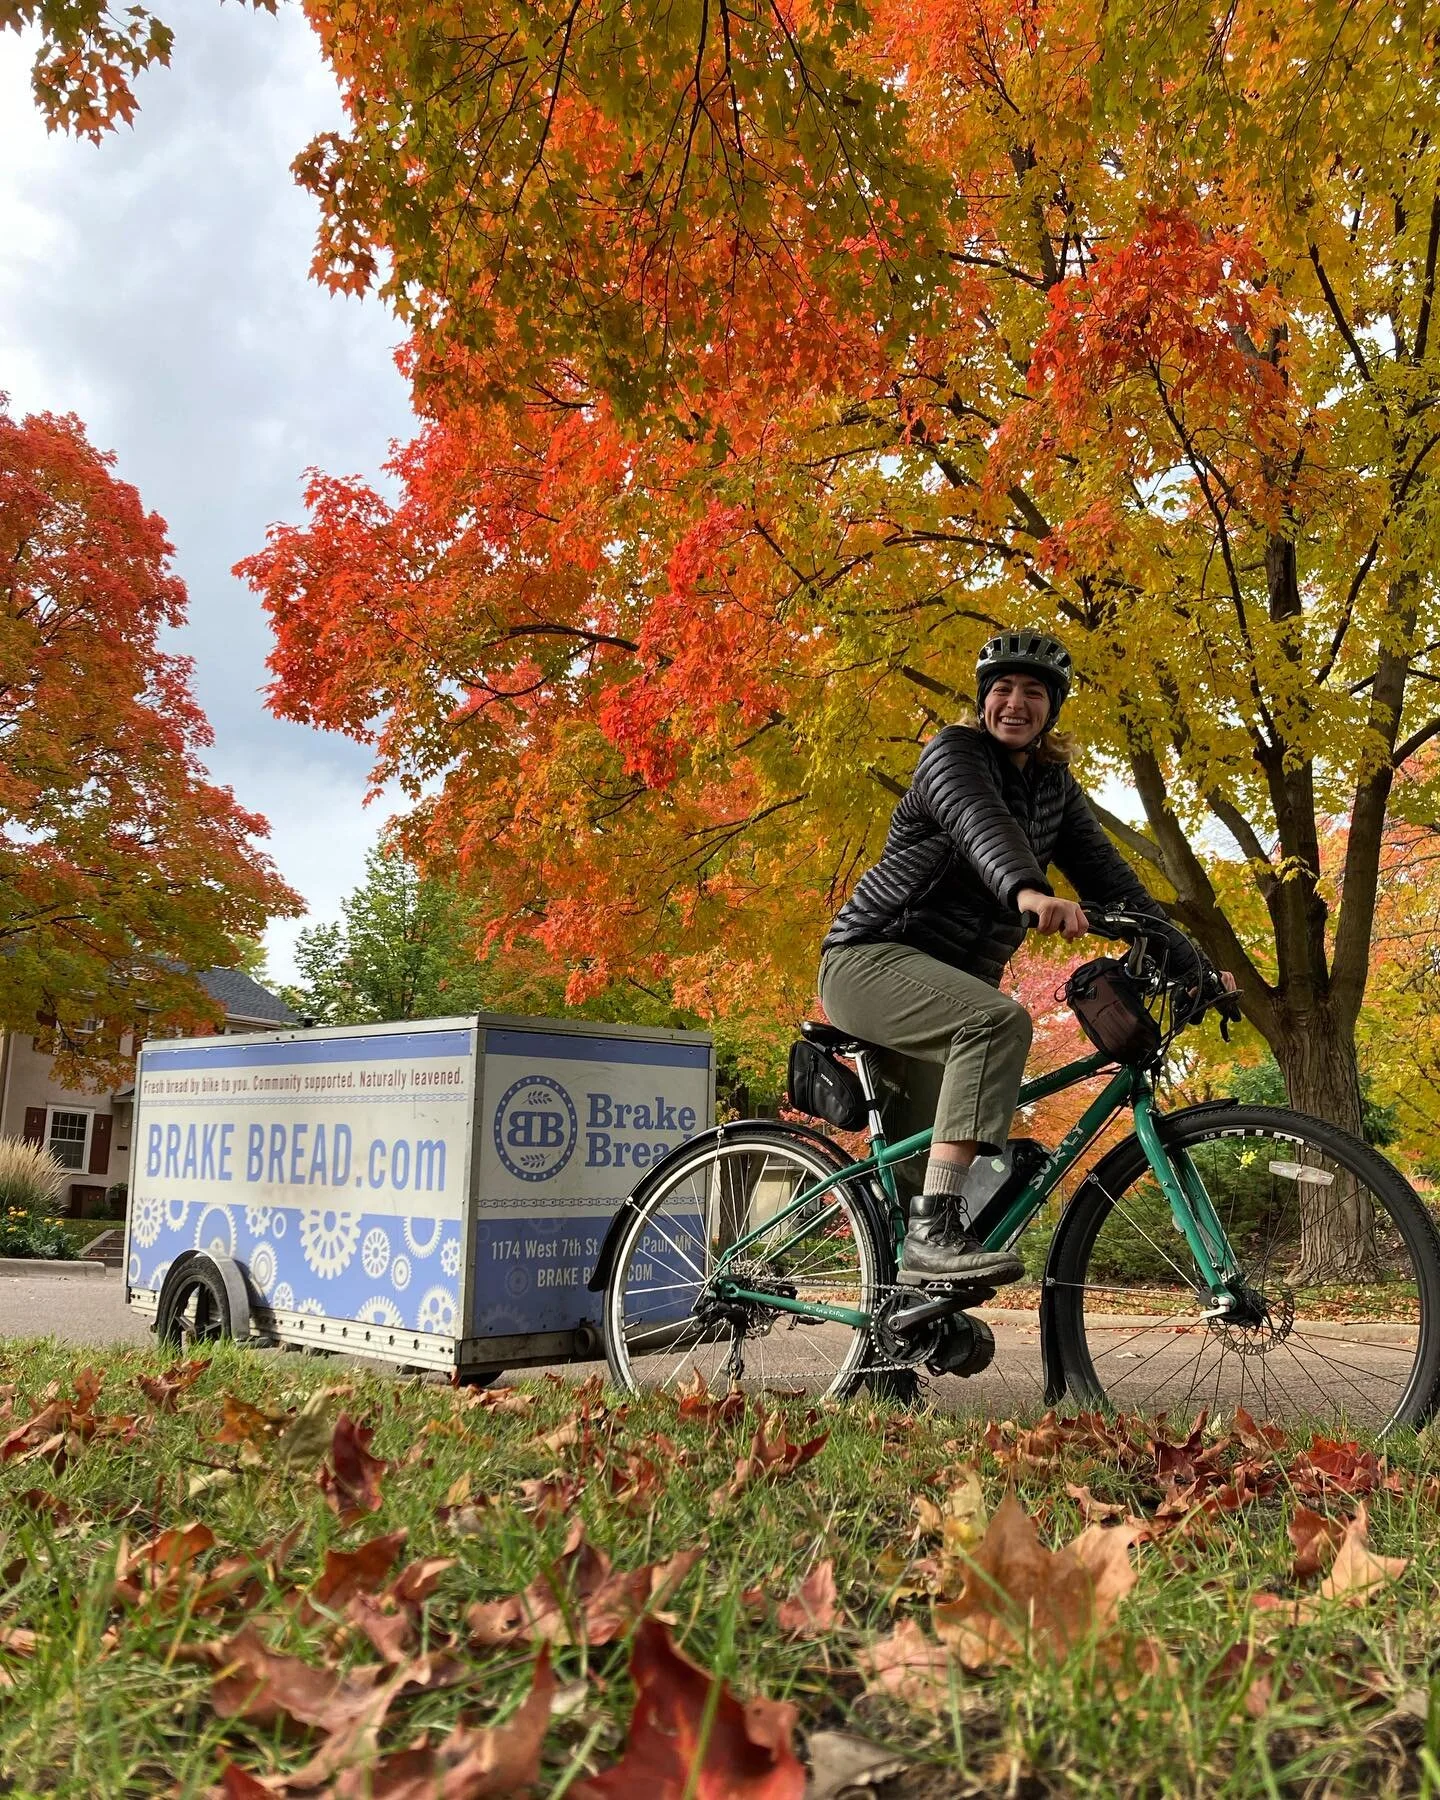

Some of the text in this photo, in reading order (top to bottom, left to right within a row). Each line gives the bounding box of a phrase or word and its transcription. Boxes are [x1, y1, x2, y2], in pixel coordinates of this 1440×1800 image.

[143, 1066, 464, 1095] Fresh bread by bike to you. Community supported. Naturally leavened.
[586, 1093, 696, 1131] Brake
[146, 1123, 447, 1192] BRAKE BREAD.com
[585, 1132, 692, 1167] Brea
[491, 1238, 521, 1260] 1174
[525, 1240, 557, 1259] West
[562, 1238, 582, 1258] 7th
[537, 1267, 578, 1288] BRAKE
